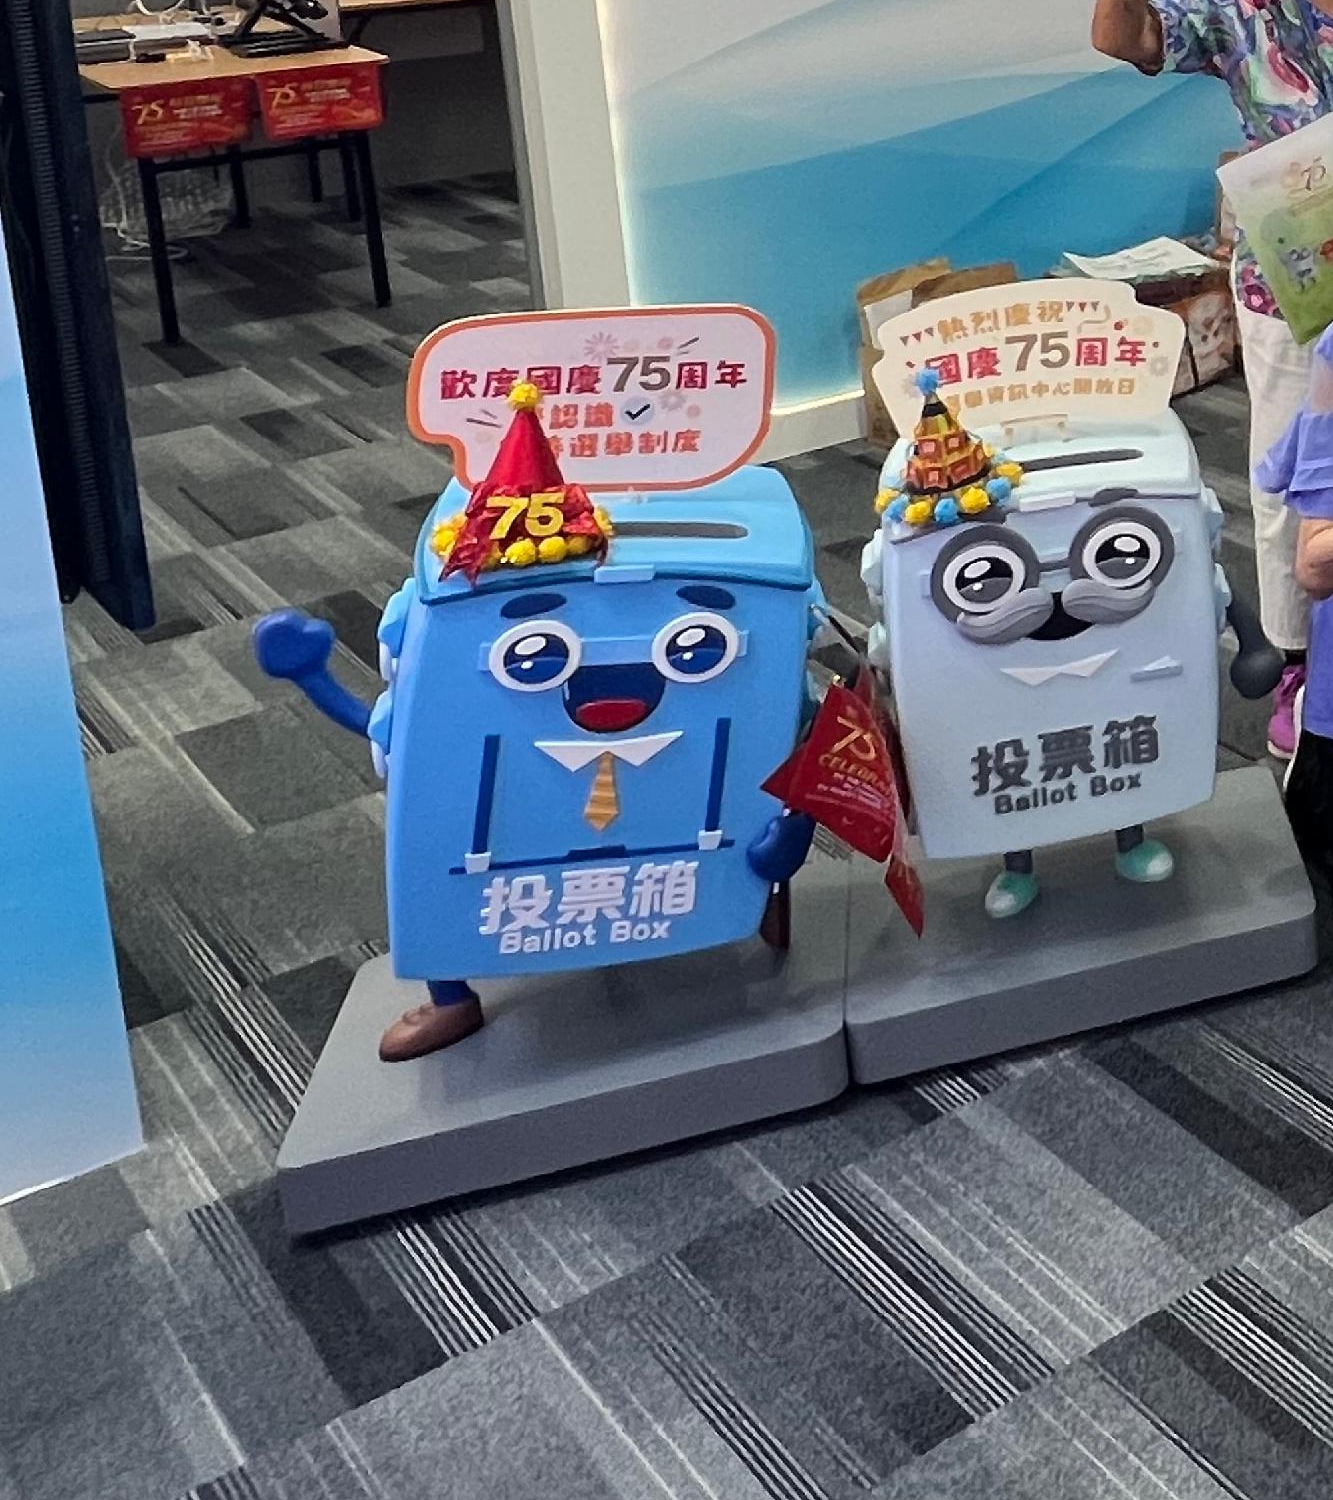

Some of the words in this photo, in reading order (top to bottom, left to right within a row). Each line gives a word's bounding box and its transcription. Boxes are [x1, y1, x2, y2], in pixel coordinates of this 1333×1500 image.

[937, 300, 1065, 344] 熱烈慶祝
[440, 355, 748, 400] 歡度國慶75周年
[925, 331, 1147, 386] 國慶75周年
[487, 492, 565, 541] 75
[836, 715, 877, 763] 75
[970, 714, 1160, 797] 投票箱
[994, 781, 1078, 815] Ballot
[1090, 772, 1142, 797] Box
[479, 860, 699, 936] 投票箱
[499, 925, 597, 956] Ballot
[610, 919, 672, 943] Box
